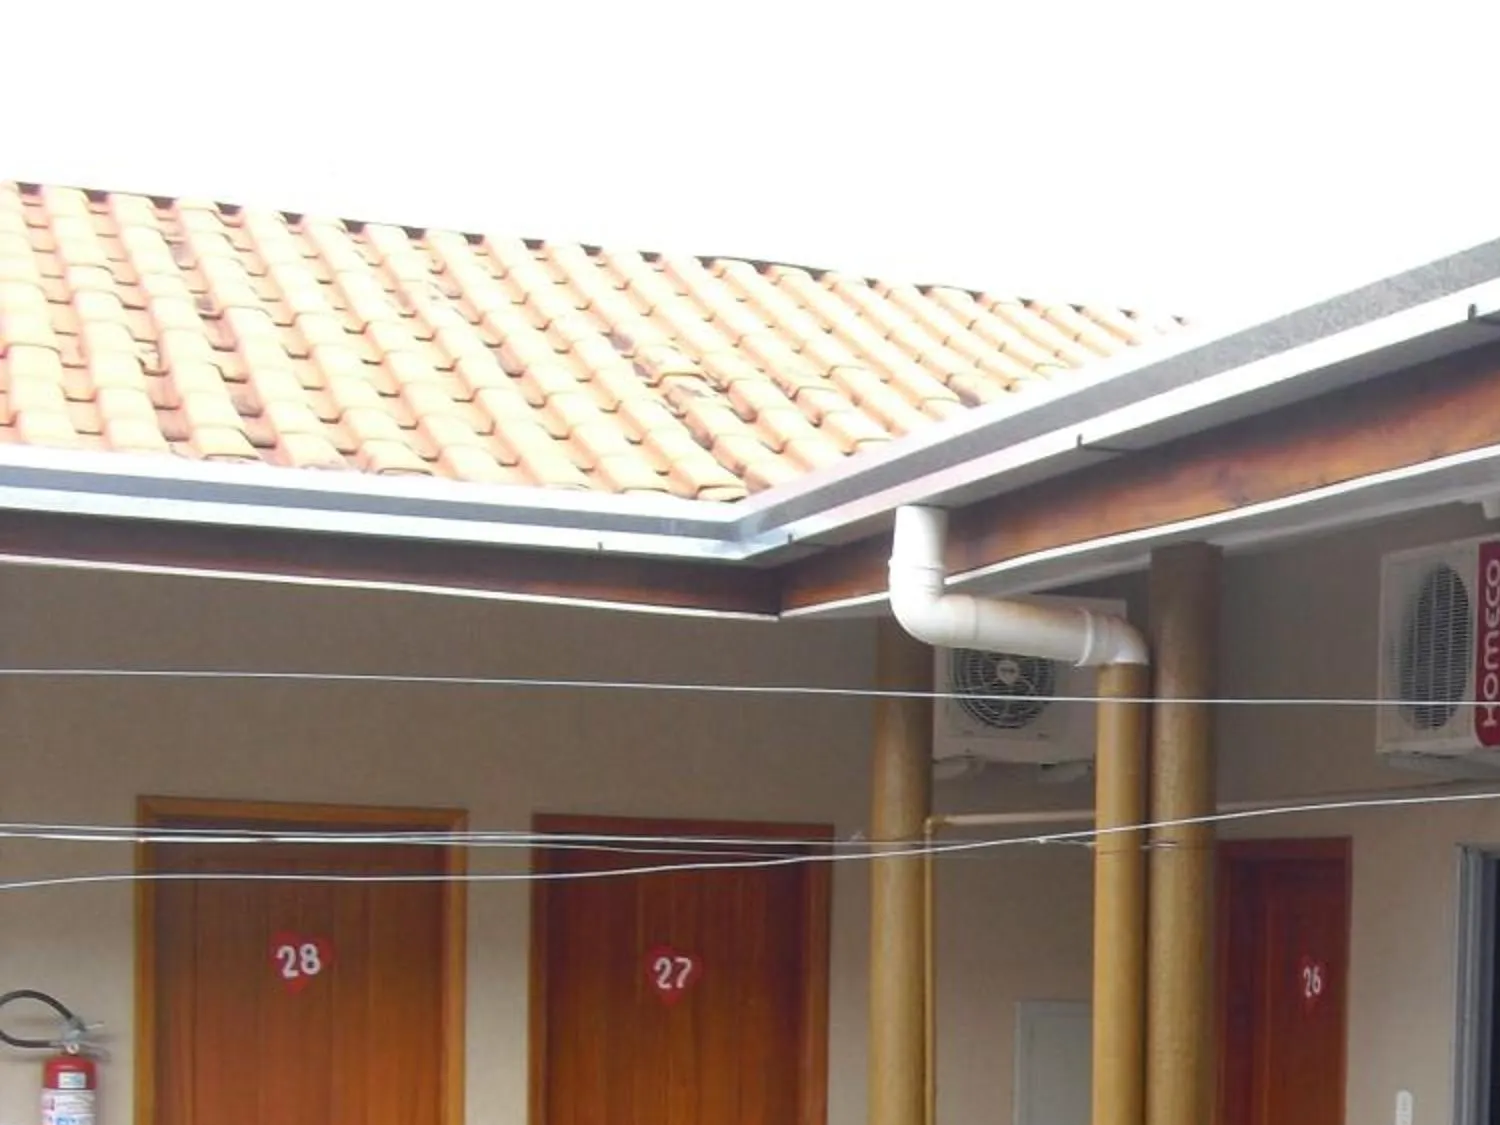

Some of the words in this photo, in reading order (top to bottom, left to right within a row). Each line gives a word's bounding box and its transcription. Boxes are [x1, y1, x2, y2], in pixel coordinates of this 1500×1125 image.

[276, 943, 321, 979] 28
[653, 956, 692, 990] 27
[1303, 966, 1322, 998] 26
